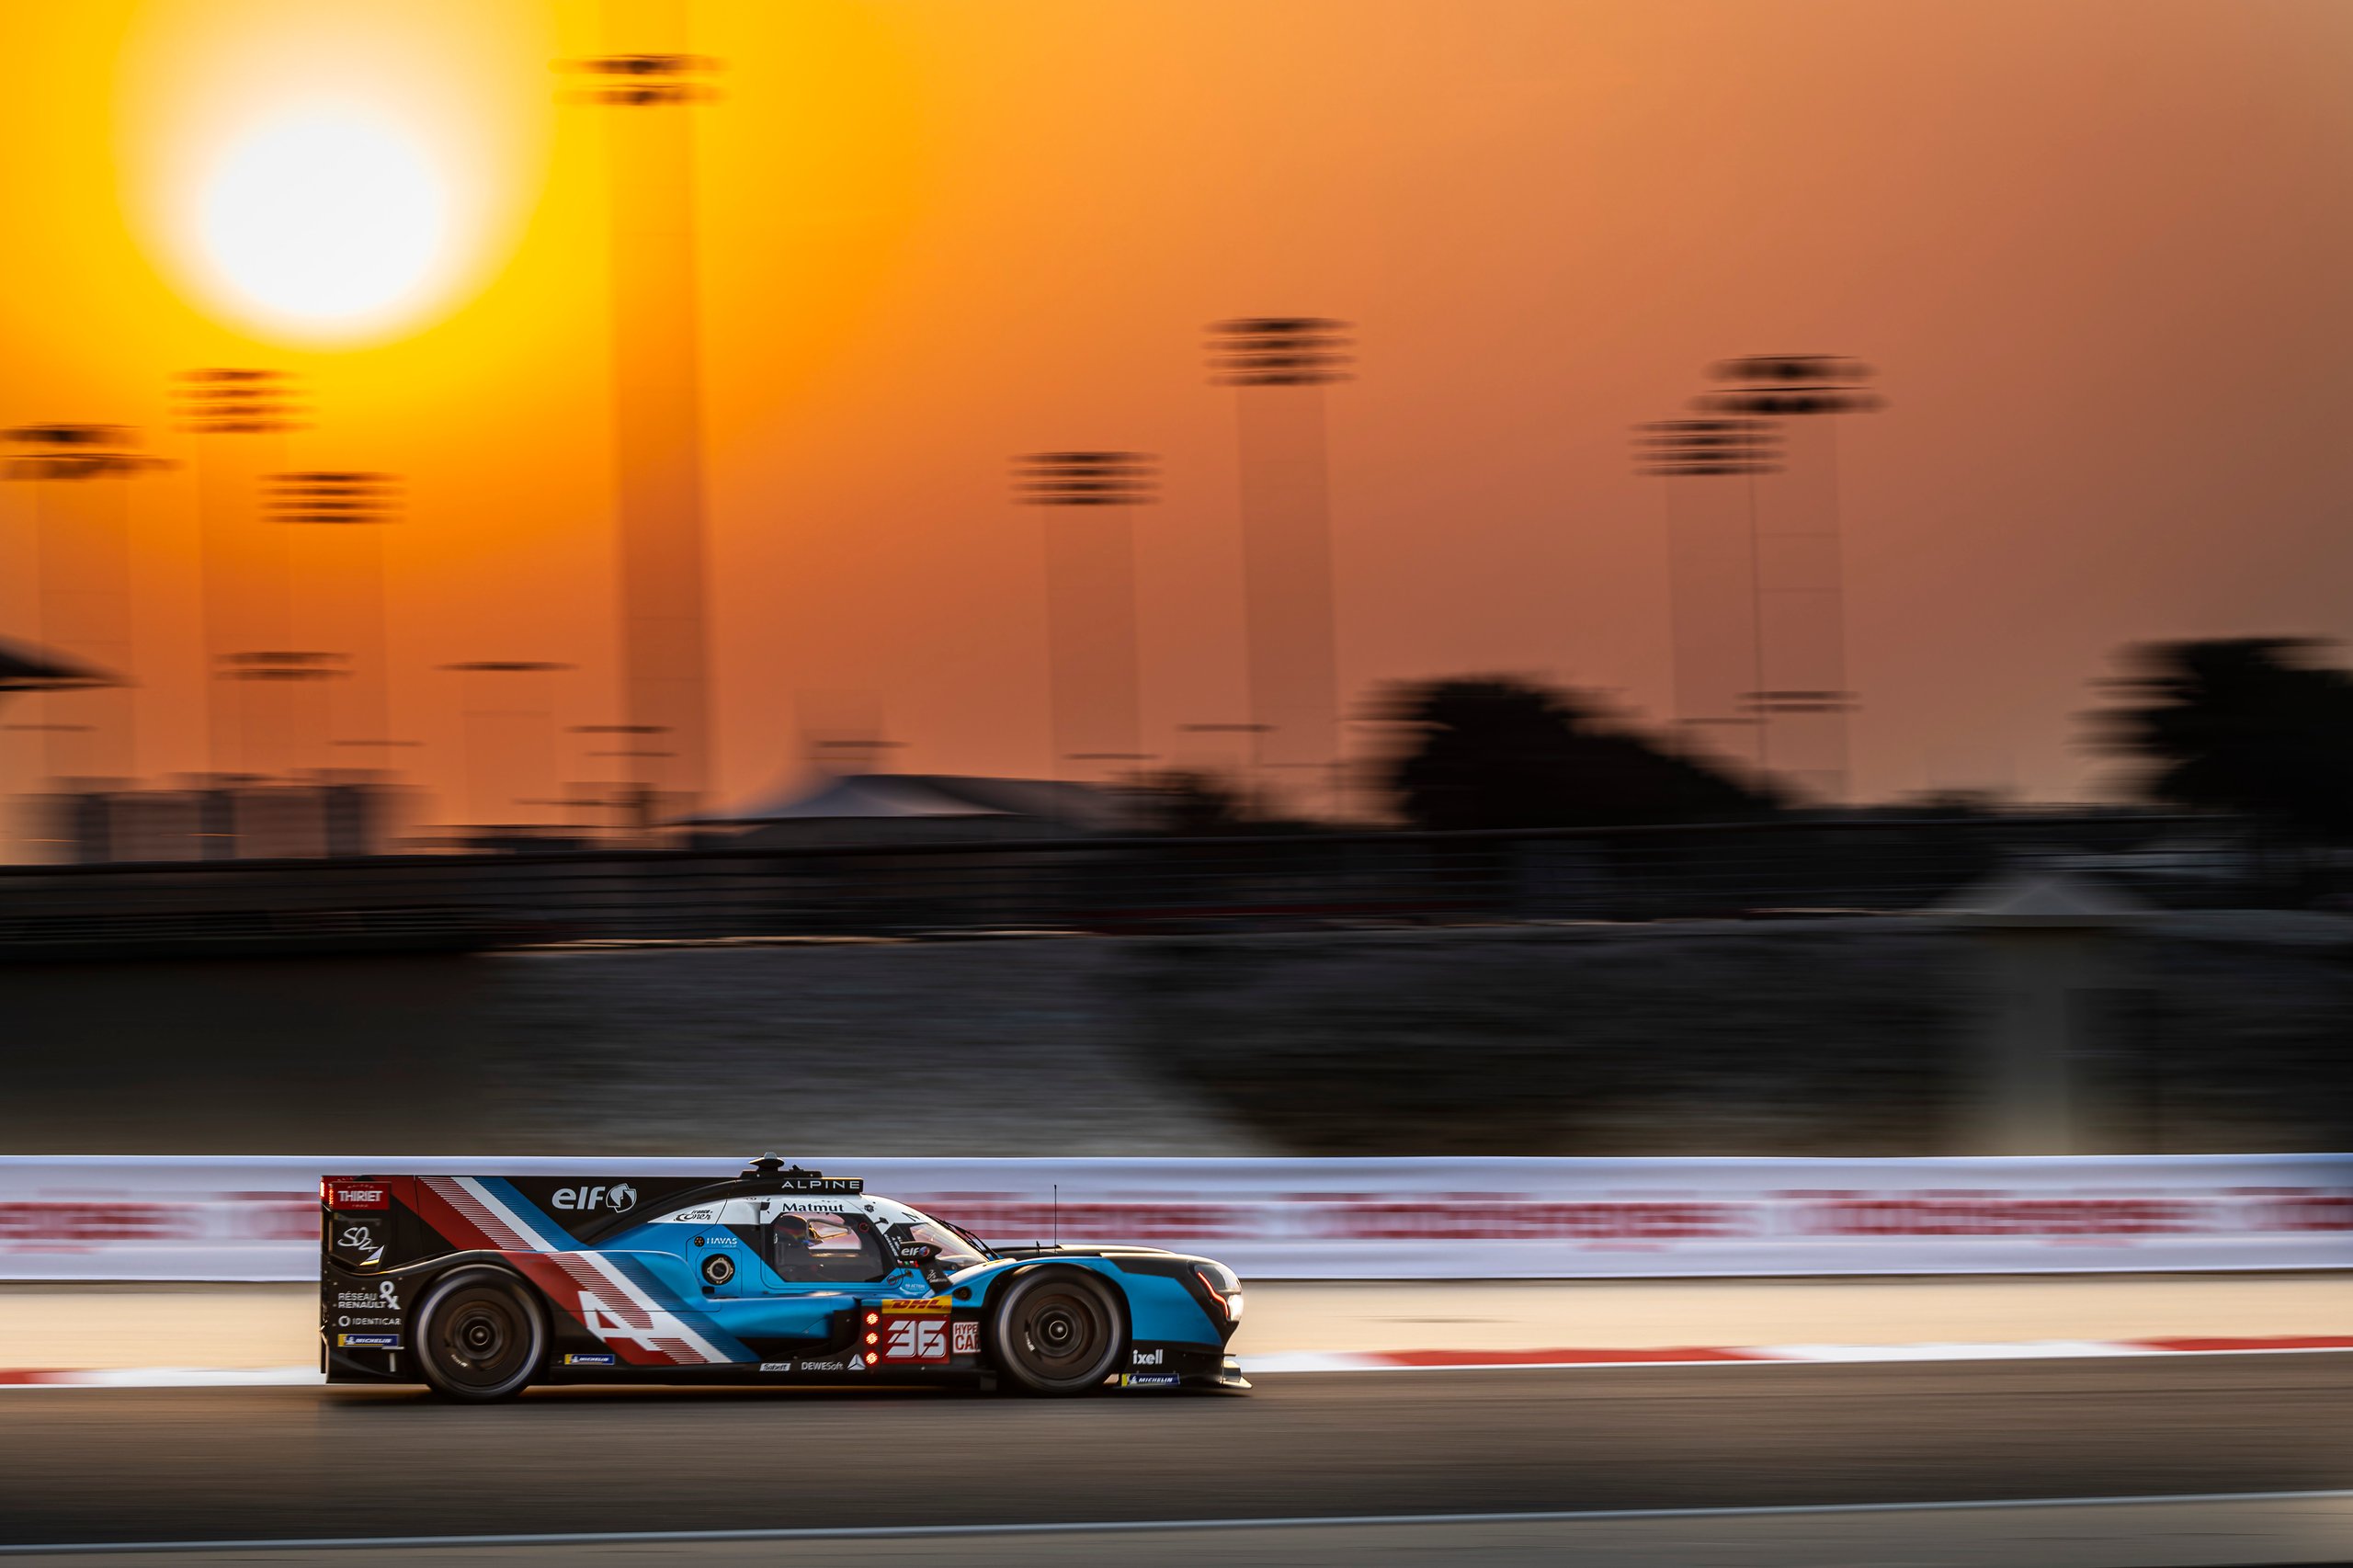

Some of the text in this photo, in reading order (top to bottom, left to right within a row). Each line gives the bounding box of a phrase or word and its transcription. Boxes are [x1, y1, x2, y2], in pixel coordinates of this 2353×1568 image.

[781, 1180, 860, 1189] ALPINE
[337, 1190, 383, 1202] THIRIET
[551, 1186, 606, 1210] elf
[782, 1202, 845, 1212] Matmut
[901, 1247, 919, 1256] elf
[337, 1301, 387, 1309] RENAULT
[891, 1299, 944, 1309] DHL
[885, 1320, 947, 1358] 36
[1132, 1348, 1164, 1365] ixell
